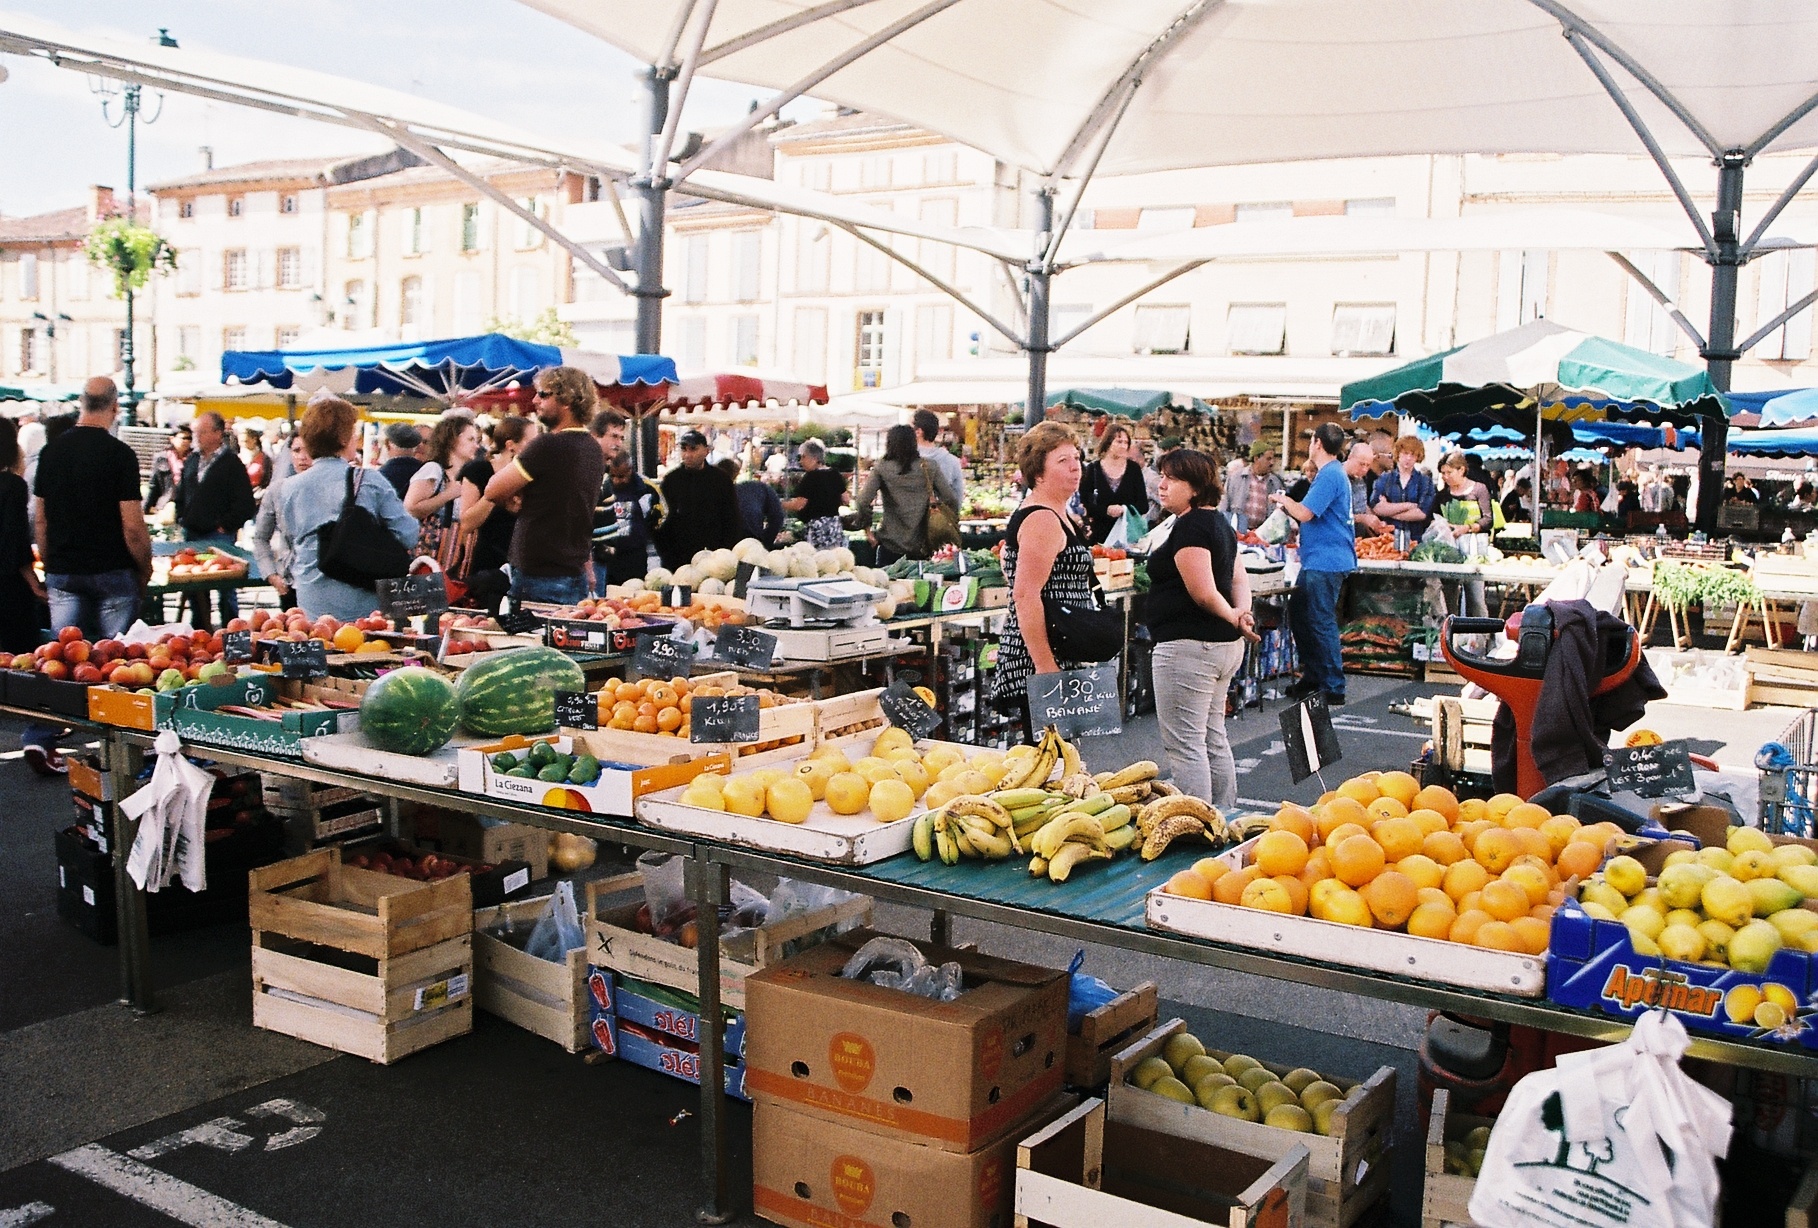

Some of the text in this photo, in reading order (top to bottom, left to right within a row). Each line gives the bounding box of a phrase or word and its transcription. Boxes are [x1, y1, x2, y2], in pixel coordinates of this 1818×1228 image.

[494, 777, 504, 789] La
[504, 780, 533, 794] Ciezana
[1604, 966, 1723, 1016] Apemar
[807, 1087, 896, 1120] BANANES
